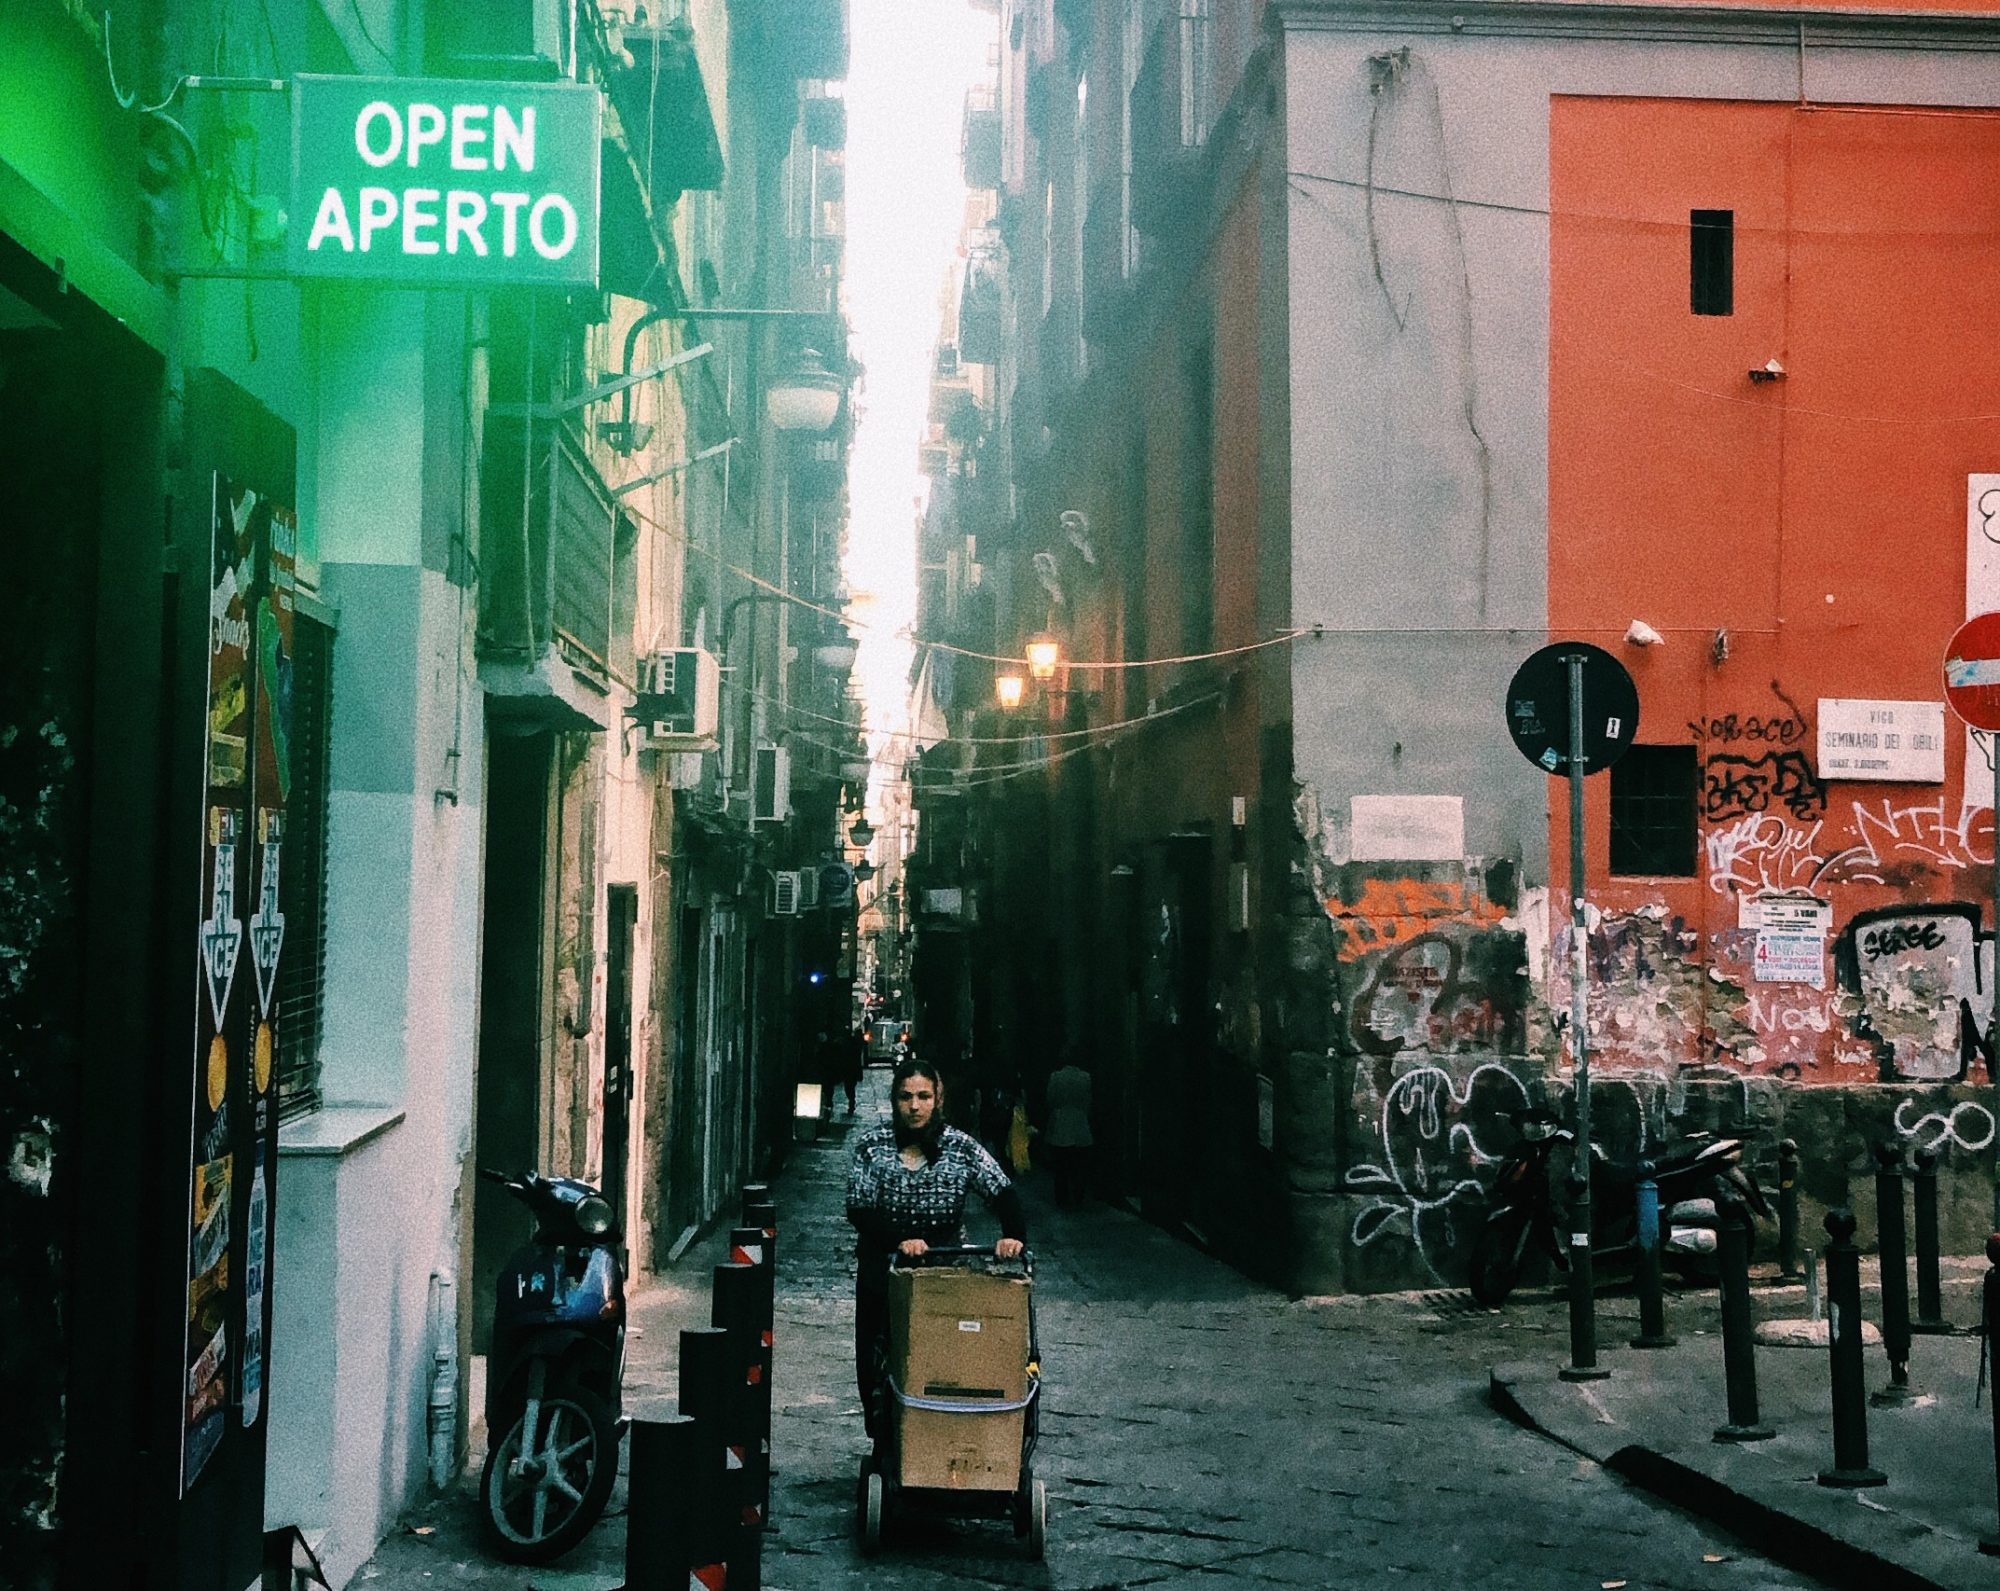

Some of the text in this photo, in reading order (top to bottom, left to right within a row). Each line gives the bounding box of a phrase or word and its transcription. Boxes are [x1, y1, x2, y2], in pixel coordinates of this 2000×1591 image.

[354, 101, 537, 172] OPEN
[307, 187, 578, 260] APERTO
[1825, 731, 1878, 750] SEMINARIO
[1884, 733, 1900, 750] DEI
[209, 937, 235, 979] ICE
[1757, 944, 1768, 963] 4
